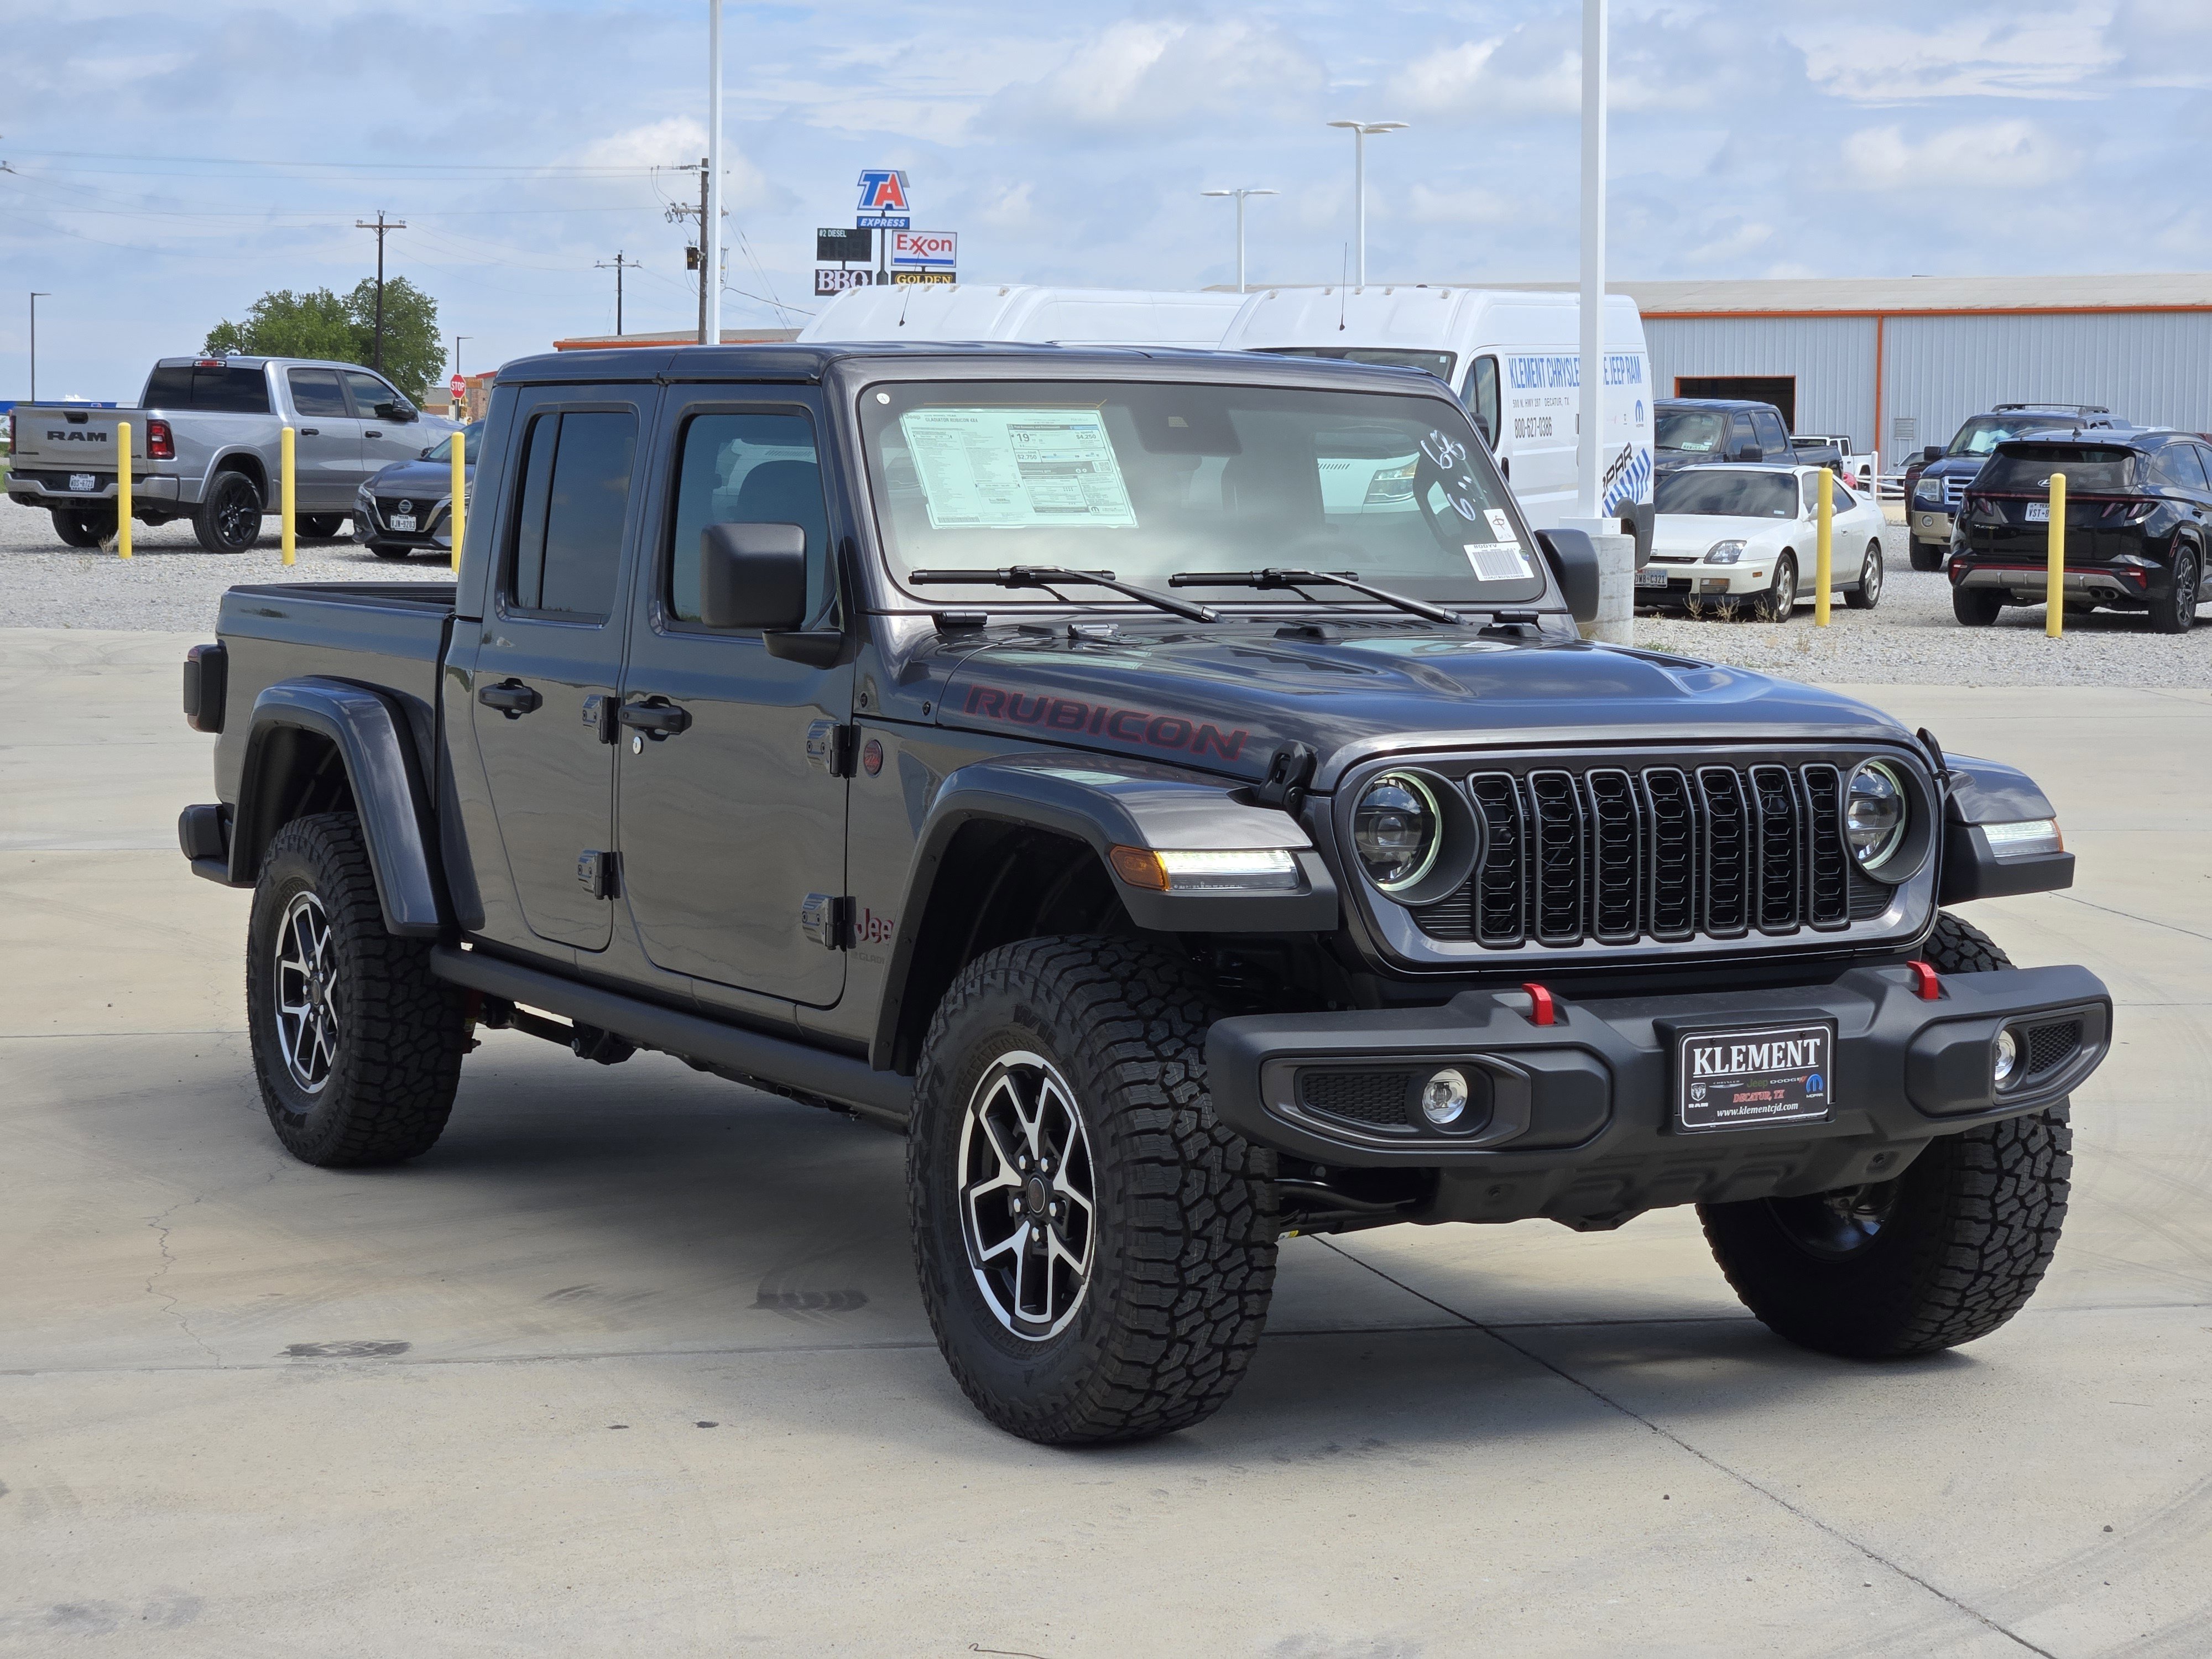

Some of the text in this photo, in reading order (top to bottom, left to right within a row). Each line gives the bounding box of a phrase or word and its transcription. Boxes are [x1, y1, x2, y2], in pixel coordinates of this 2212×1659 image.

[862, 173, 904, 206] TA
[860, 218, 905, 227] EXPRESS
[897, 234, 952, 257] Exxon
[818, 270, 869, 290] BBQ
[895, 274, 952, 284] GOLDEN
[1508, 357, 1546, 388] KLEMENT
[1546, 357, 1580, 388] CHRYSLE
[1609, 356, 1625, 385] JEEP
[1625, 356, 1642, 384] RAM
[451, 381, 465, 392] STOP
[1564, 397, 1569, 405] TX
[1514, 416, 1552, 439] 800-627-0386
[47, 431, 107, 442] RAM
[1017, 434, 1029, 442] 19
[1603, 442, 1633, 499] PAR
[963, 684, 1250, 762] RUBICON
[854, 907, 894, 945] Jee
[1693, 1039, 1820, 1075] KLEMENT
[1746, 1078, 1768, 1088] Jeep
[1773, 1089, 1785, 1099] TX
[1717, 1103, 1798, 1117] www.klementcjd.com
